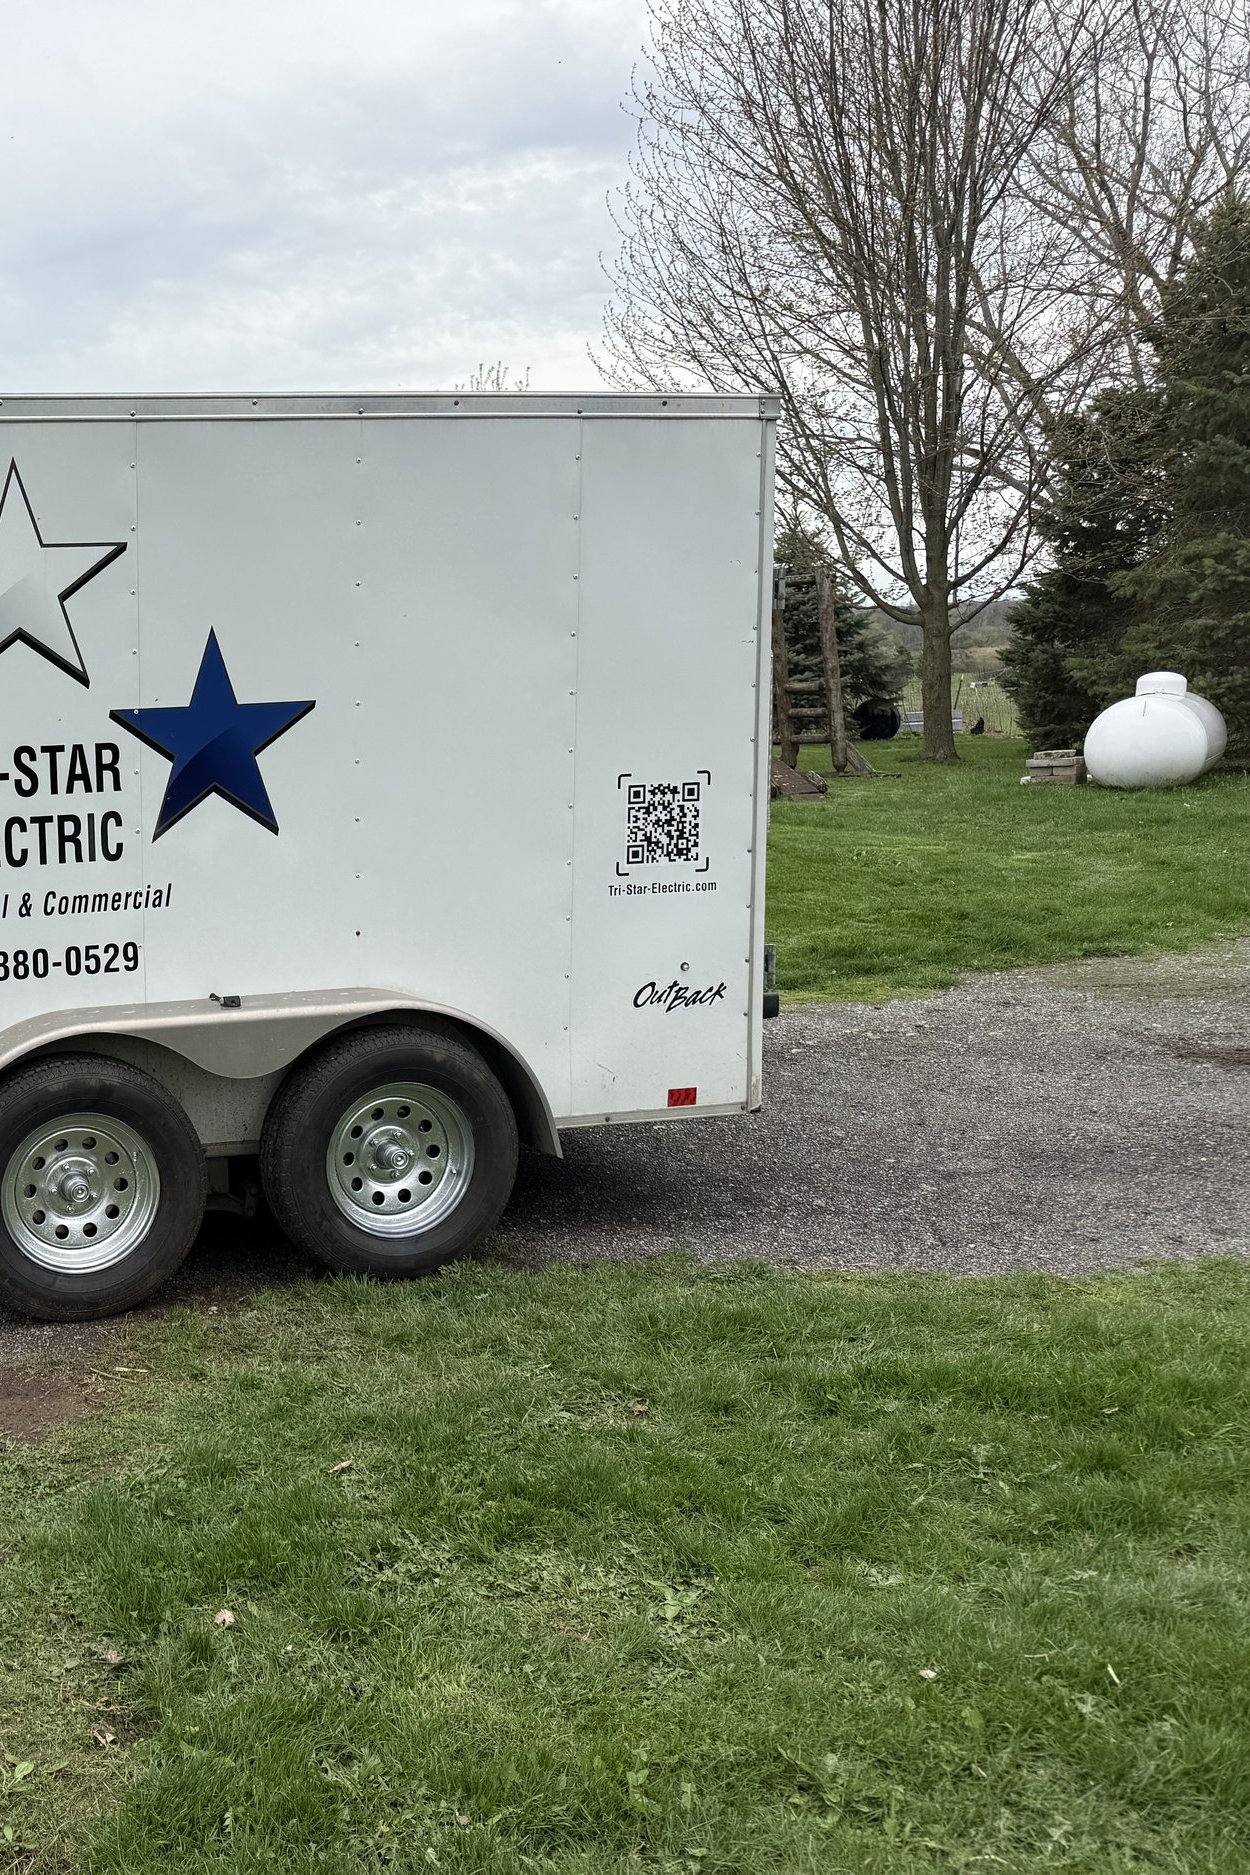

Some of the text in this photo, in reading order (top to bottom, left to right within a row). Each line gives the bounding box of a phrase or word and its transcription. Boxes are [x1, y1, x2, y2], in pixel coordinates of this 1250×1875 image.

[18, 892, 34, 918] &
[43, 883, 172, 917] Commercial
[608, 880, 718, 897] Tri-Star-Electric.com
